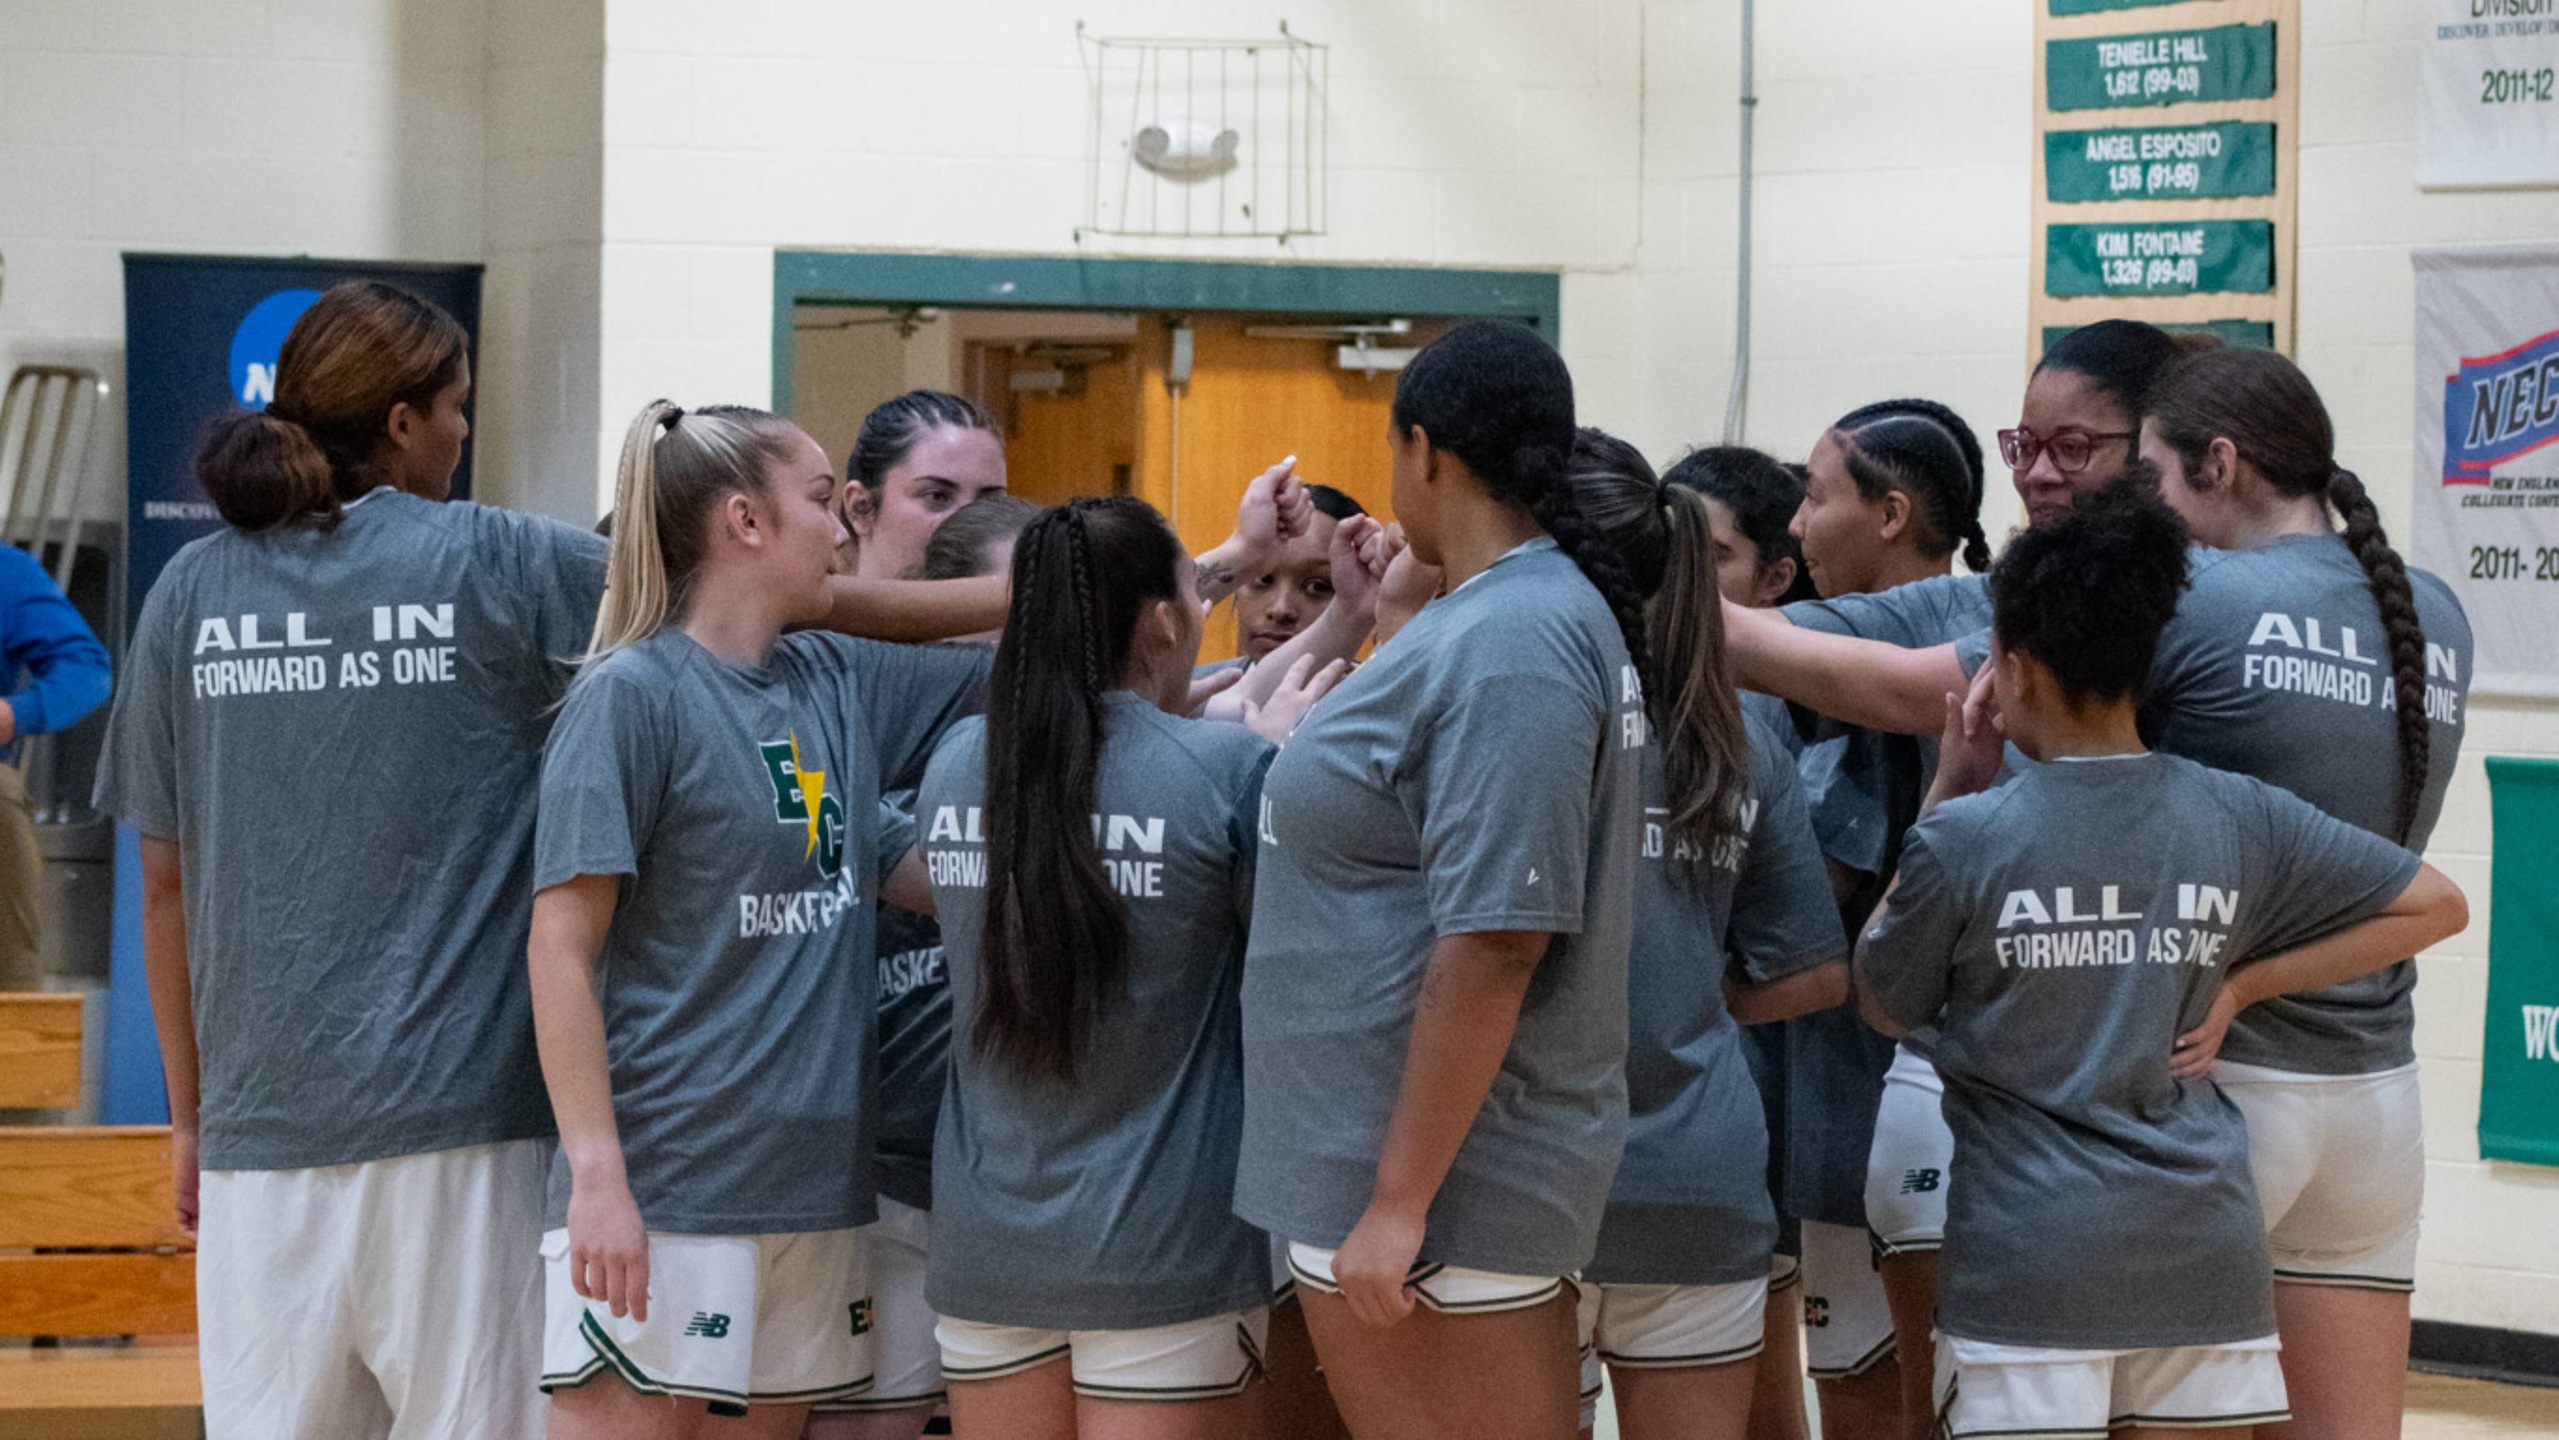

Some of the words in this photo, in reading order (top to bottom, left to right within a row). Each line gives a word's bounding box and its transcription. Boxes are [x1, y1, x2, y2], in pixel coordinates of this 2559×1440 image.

[2098, 39, 2170, 67] TENIELLE
[2174, 37, 2207, 62] HILL
[2104, 70, 2139, 98] 1,612
[2144, 66, 2199, 97] (99-03)
[2481, 68, 2554, 103] 2011-12
[2086, 135, 2137, 161] ANGEL
[2140, 131, 2221, 158] ESPOSITO
[2097, 232, 2129, 257] KIM
[2133, 230, 2204, 256] FONTAINE
[2102, 258, 2142, 287] 1,326
[2493, 477, 2515, 490] NEW
[2461, 495, 2525, 508] COLLEGIATE
[194, 612, 332, 656] ALL
[373, 603, 454, 641] IN
[2247, 612, 2378, 667] ALL
[2425, 641, 2458, 683] N
[193, 655, 327, 699] FORWARD
[339, 651, 380, 689] AS
[393, 647, 457, 685] ONE
[2243, 653, 2372, 707] FORWARD
[2380, 676, 2398, 713] A
[2423, 685, 2459, 726] ONE
[928, 805, 986, 843] AL
[1996, 885, 2143, 928] ALL
[2177, 883, 2239, 925] IN
[1995, 928, 2135, 969] FORWARD
[2147, 927, 2182, 964] AS
